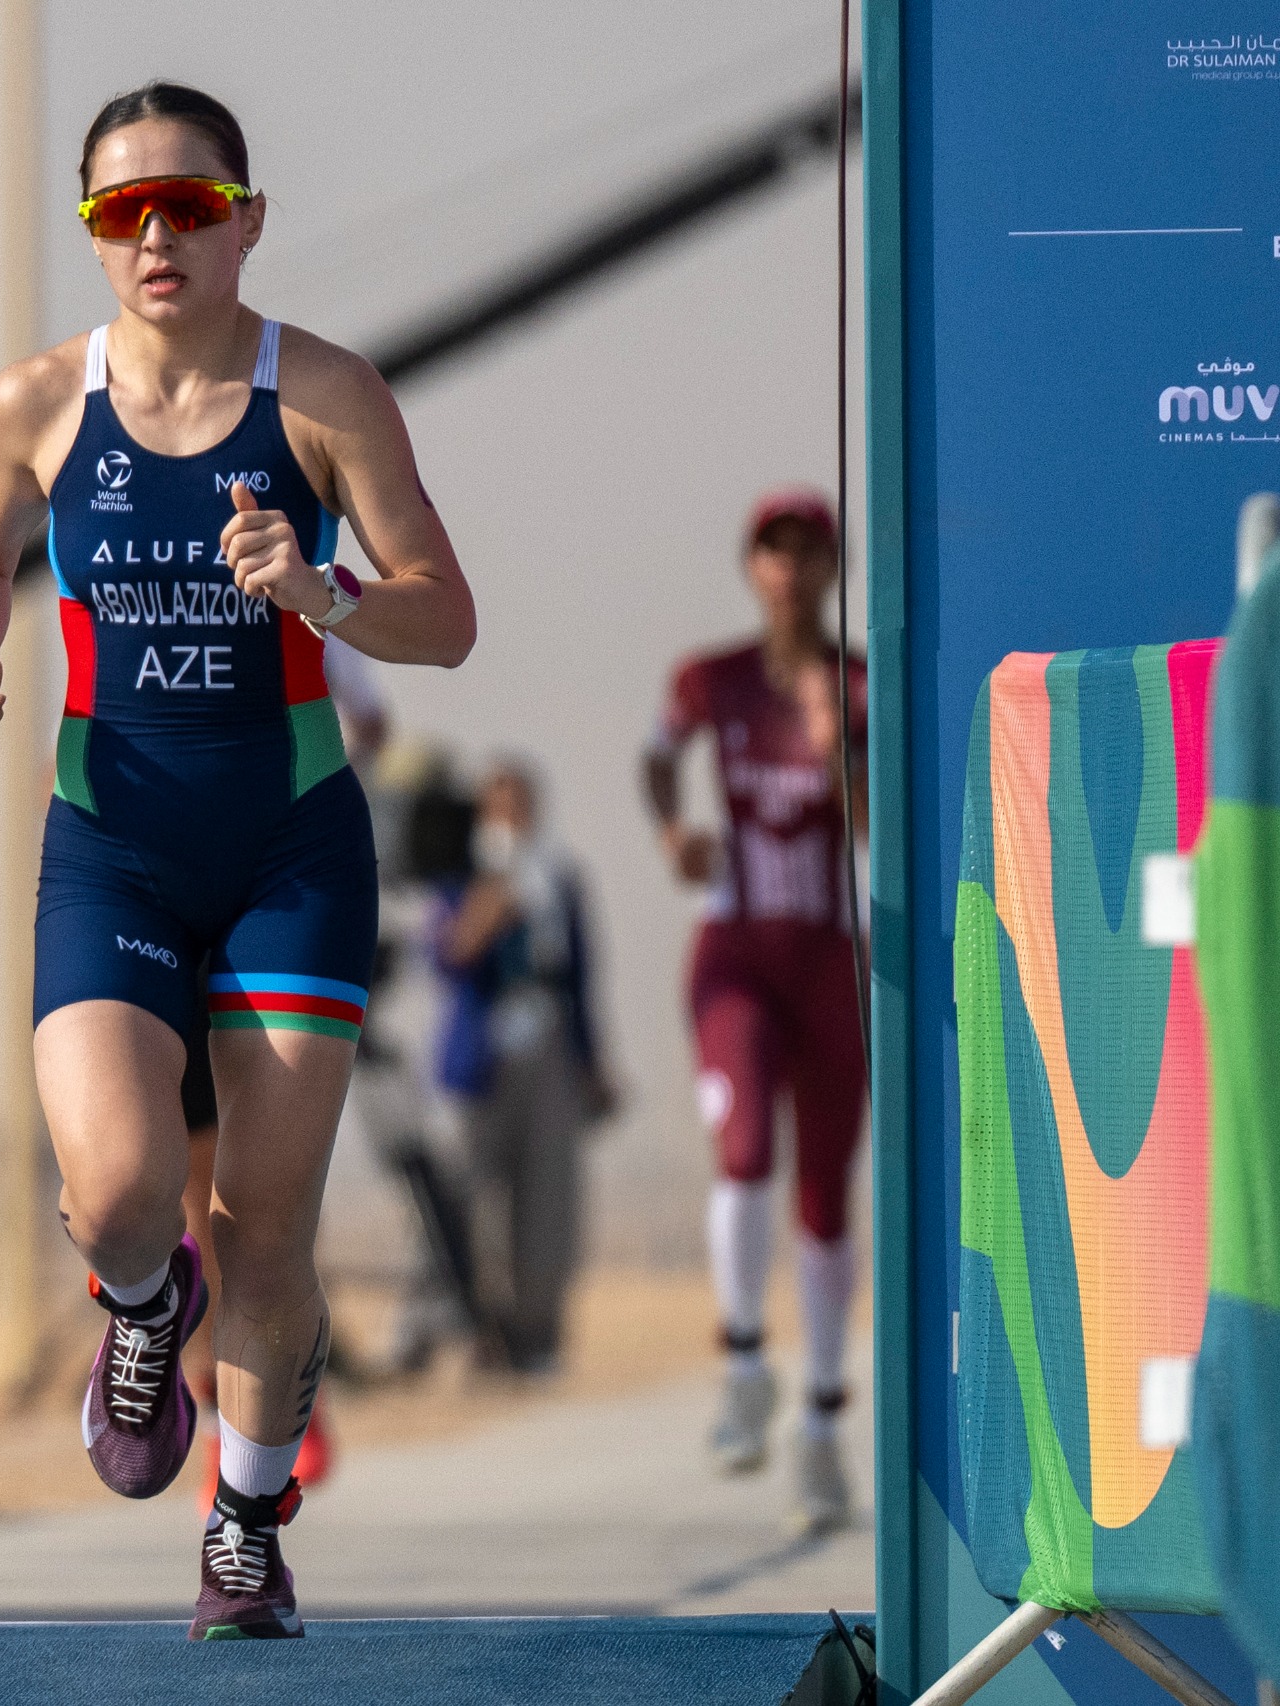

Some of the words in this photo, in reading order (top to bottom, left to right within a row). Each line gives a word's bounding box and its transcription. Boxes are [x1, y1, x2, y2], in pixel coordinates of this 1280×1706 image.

[1167, 35, 1240, 53] الحبيب
[1167, 54, 1189, 68] DR
[1193, 53, 1276, 67] SULAIMAN
[1191, 70, 1231, 80] medical
[1232, 71, 1263, 81] group
[1159, 433, 1224, 442] CINEMAS
[97, 490, 127, 501] World
[90, 499, 133, 512] Triathlon
[91, 581, 270, 625] ABDULAZIZOVA
[135, 645, 235, 690] AZE
[116, 934, 178, 968] MAKO
